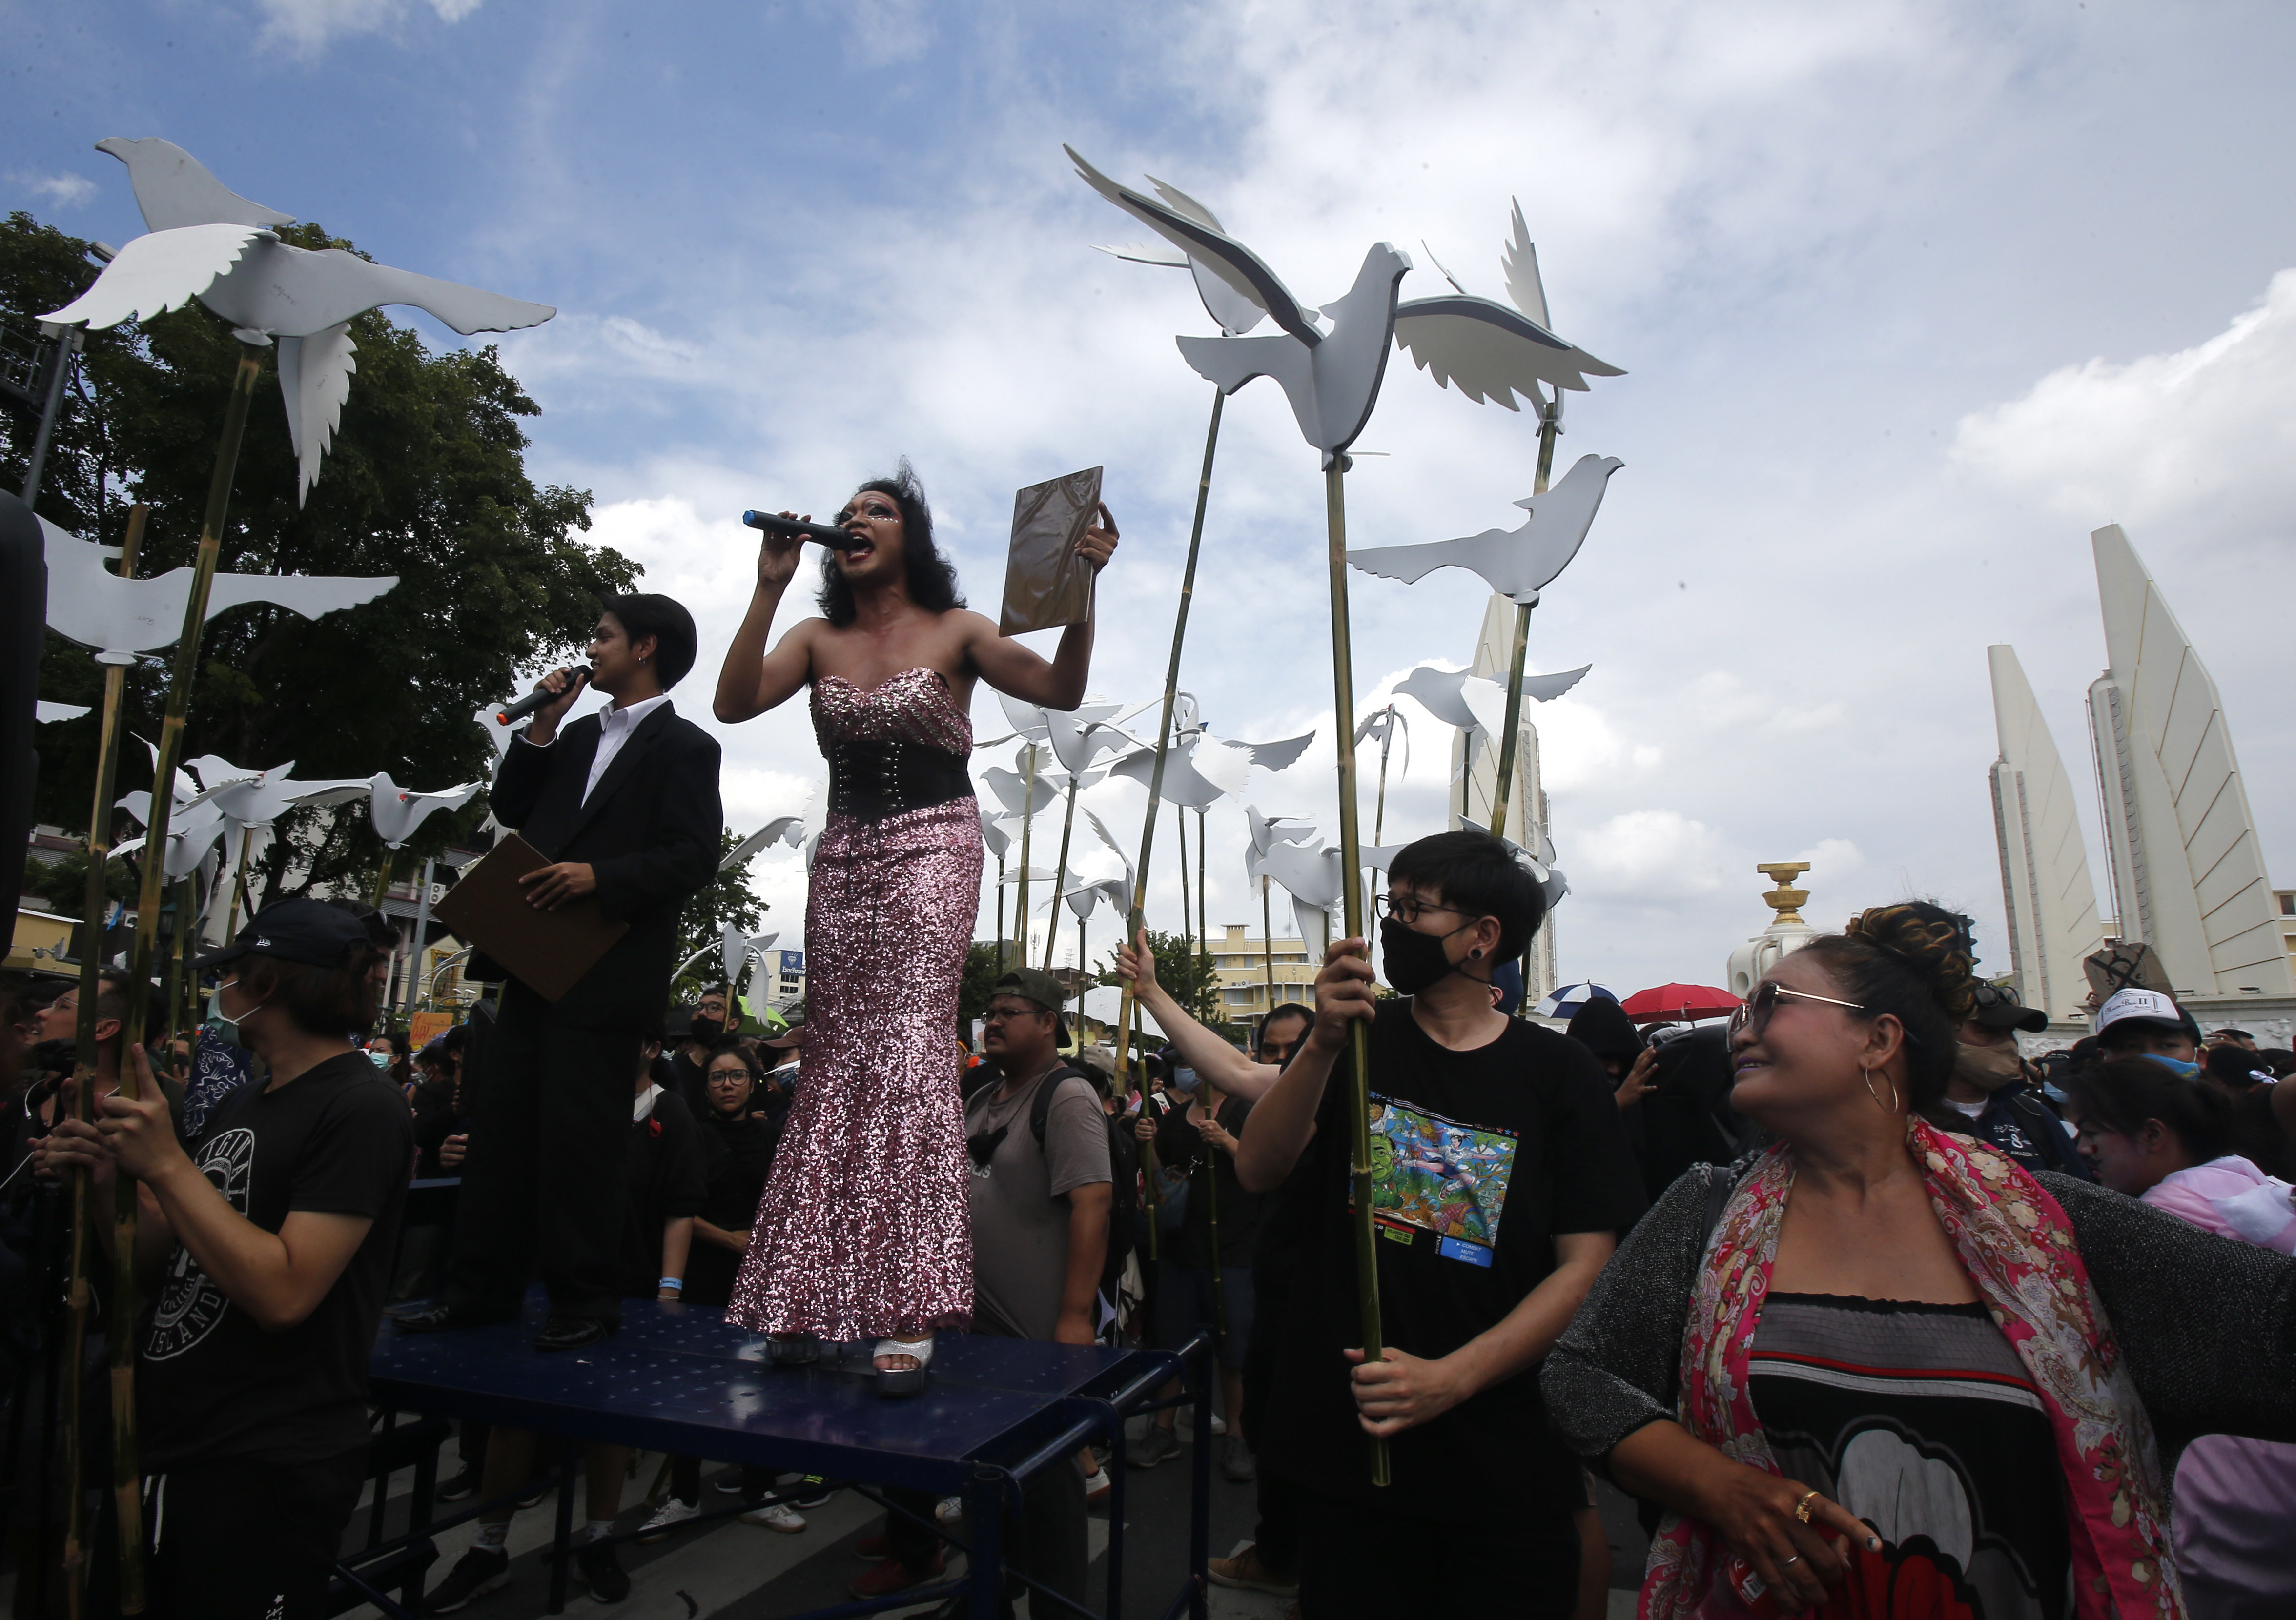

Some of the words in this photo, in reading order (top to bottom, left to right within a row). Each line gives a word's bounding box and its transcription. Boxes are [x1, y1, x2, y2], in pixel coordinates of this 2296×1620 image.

[194, 1132, 251, 1202] IGINAL
[1462, 1243, 1482, 1252] COMBAT
[1460, 1255, 1478, 1263] ESCAPE
